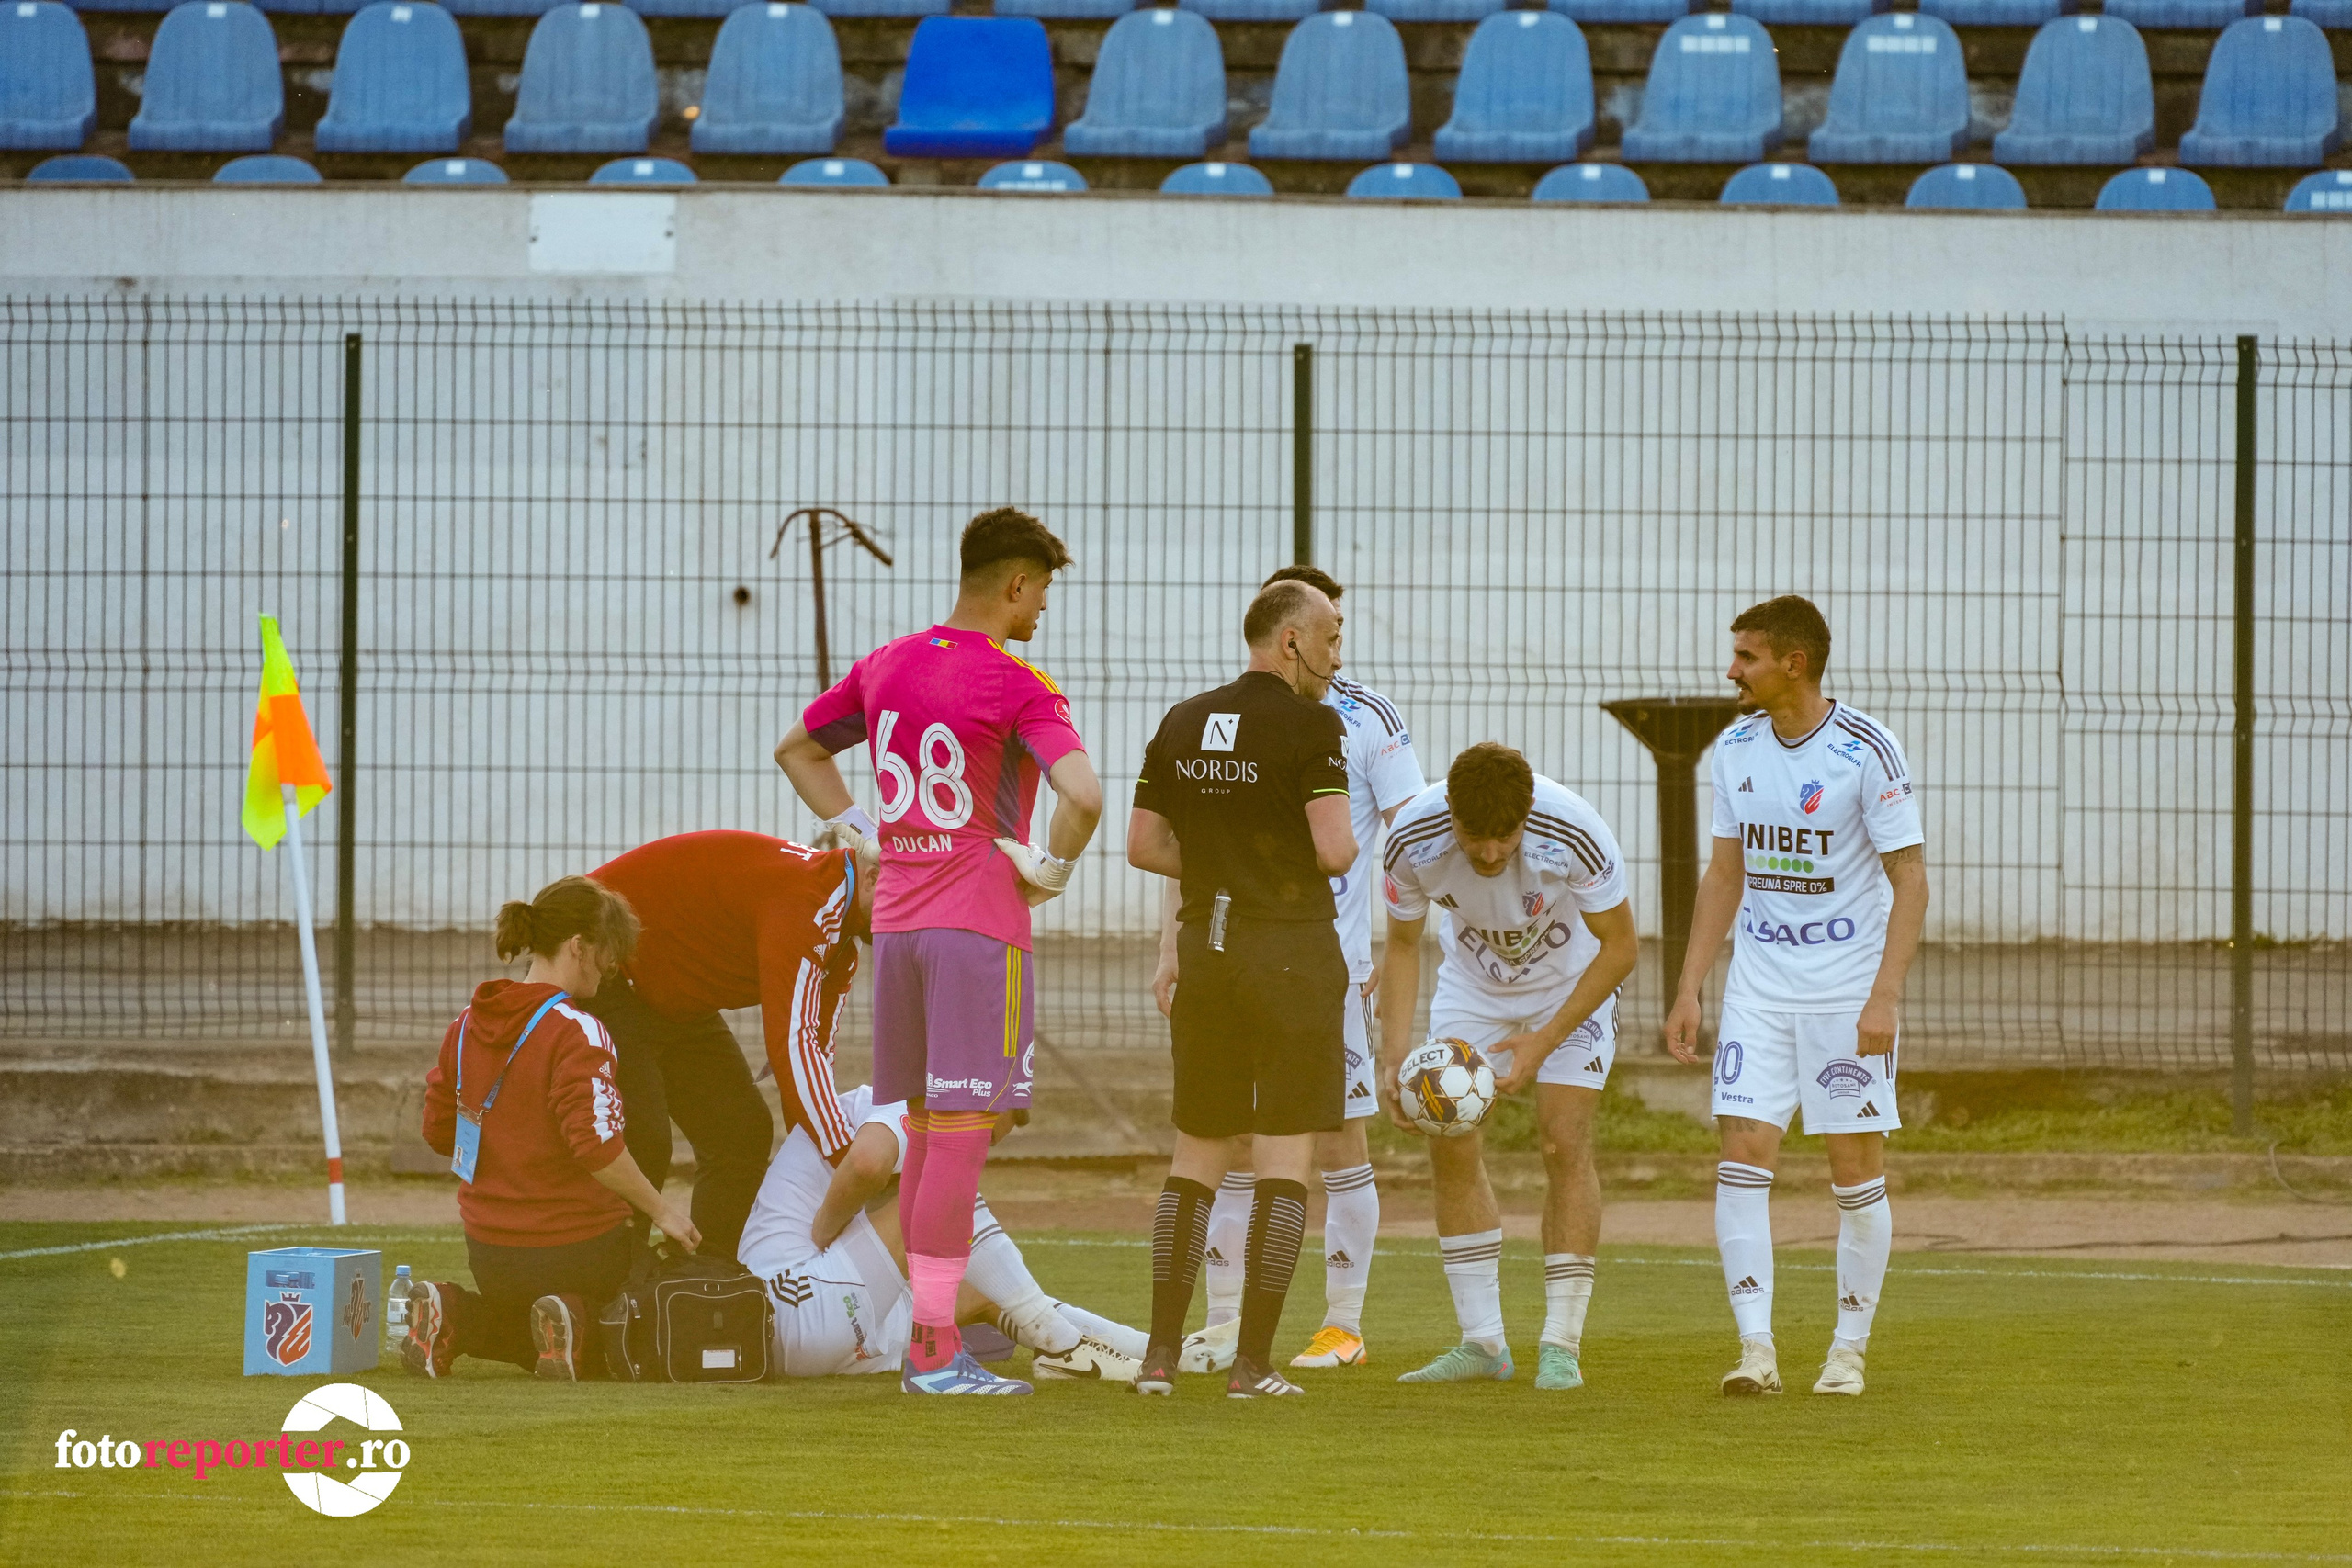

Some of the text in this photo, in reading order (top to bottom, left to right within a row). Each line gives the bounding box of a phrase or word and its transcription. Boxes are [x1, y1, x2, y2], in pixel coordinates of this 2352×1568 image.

[1381, 740, 1400, 756] ABC
[1826, 743, 1862, 768] ELECTROALFA
[876, 710, 973, 829] 68
[1175, 759, 1258, 783] NORDIS
[1880, 788, 1900, 802] ABC
[892, 834, 953, 853] DUCAN
[1748, 875, 1827, 893] PREUNĂ SPRE 0%
[1401, 1048, 1445, 1078] SELECT
[933, 1077, 992, 1089] Smart Eco
[1820, 1066, 1871, 1085] FIVE CONTINENTS
[972, 1089, 991, 1098] Plus
[1721, 1091, 1754, 1105] Vestra
[1731, 1285, 1764, 1296] adidas
[842, 1295, 855, 1319] Eco
[850, 1292, 861, 1311] Plus
